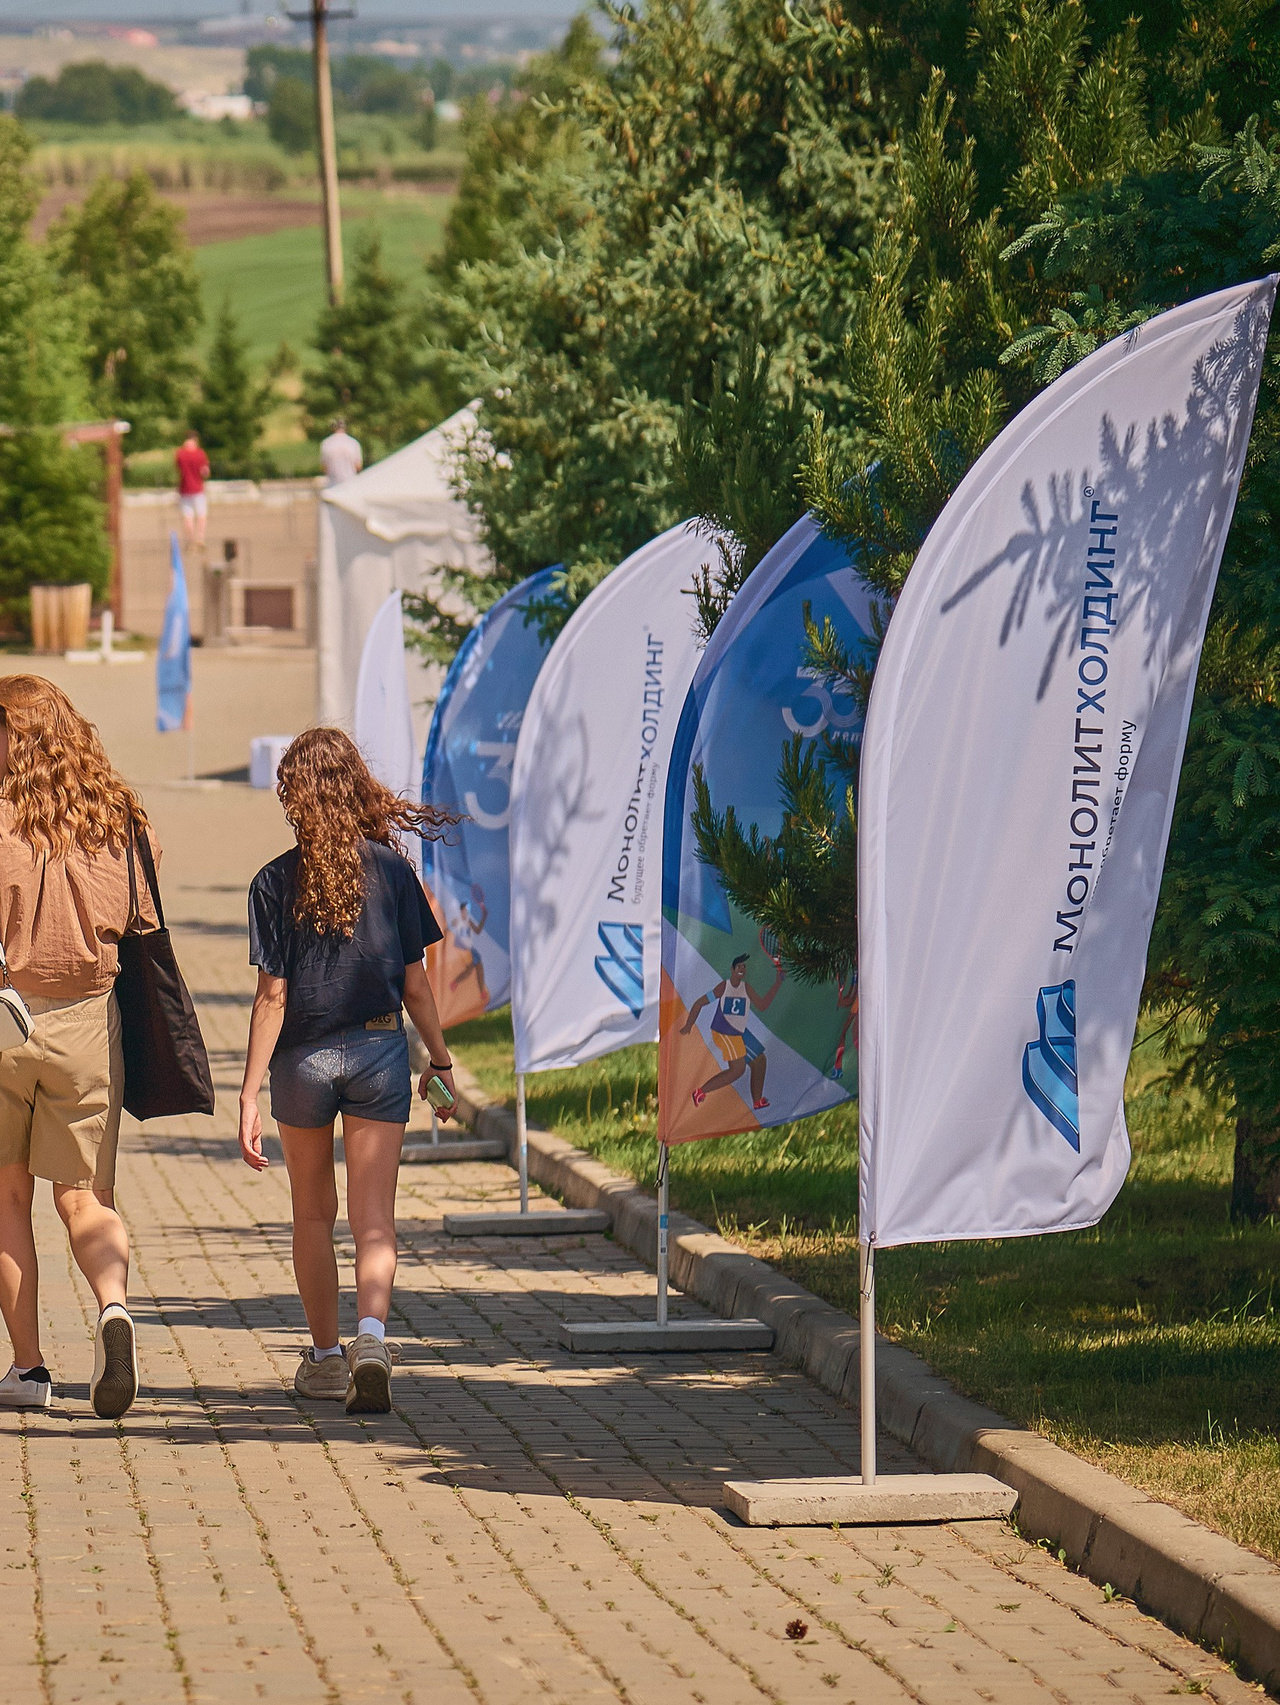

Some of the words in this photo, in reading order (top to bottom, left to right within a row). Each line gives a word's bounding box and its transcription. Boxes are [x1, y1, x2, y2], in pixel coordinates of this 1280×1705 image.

[1113, 719, 1136, 781] форму
[631, 856, 645, 905] будущее
[645, 762, 659, 799] форму
